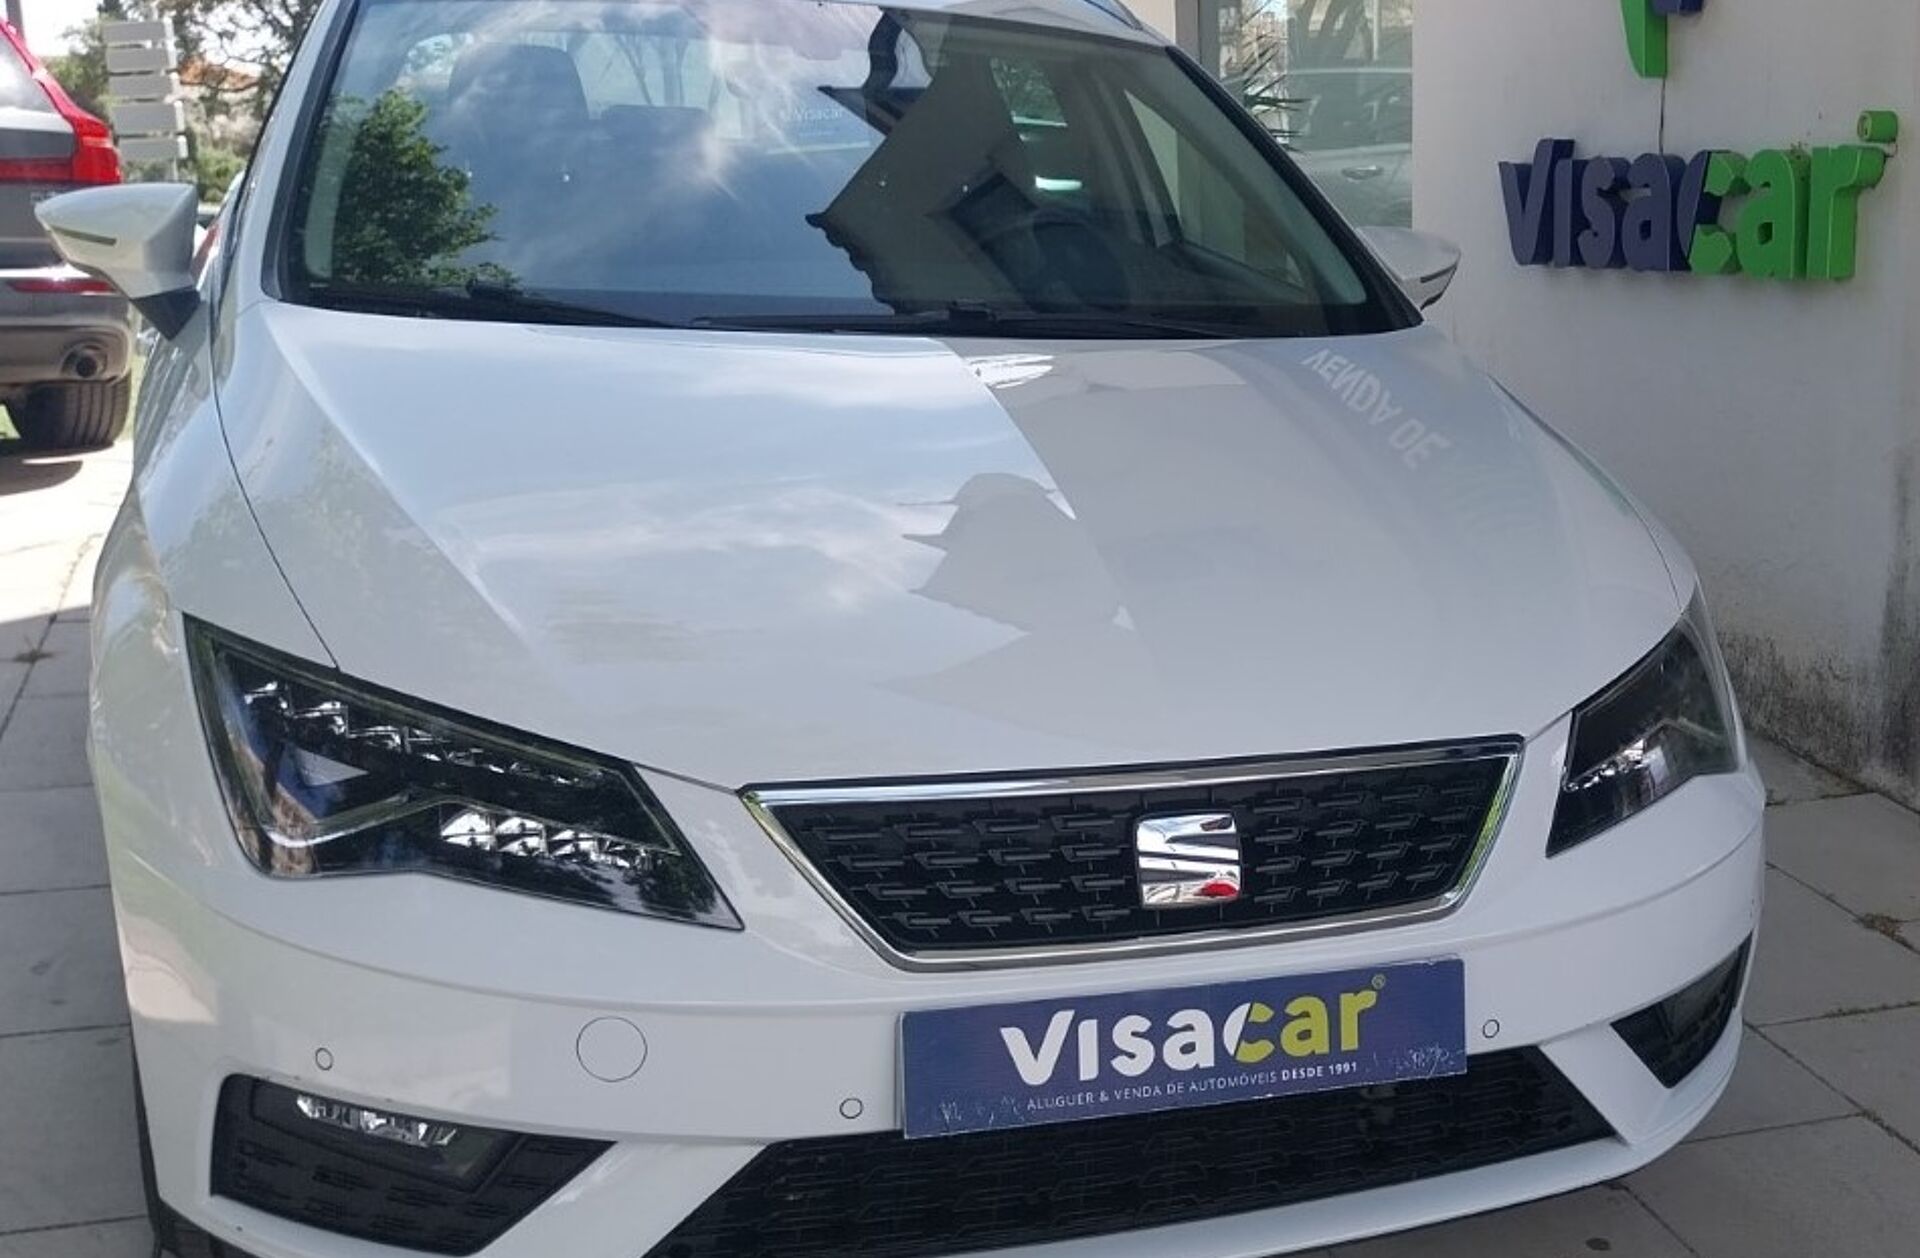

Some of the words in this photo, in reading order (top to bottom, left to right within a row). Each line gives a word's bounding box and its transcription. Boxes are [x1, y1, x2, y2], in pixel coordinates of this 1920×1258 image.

[1027, 1092, 1095, 1110] ALUGUER
[1100, 1090, 1110, 1103] &
[1114, 1085, 1162, 1100] VENDA
[1166, 1081, 1185, 1095] DE
[1189, 1070, 1278, 1092] AUTOMÓVEIS
[1282, 1066, 1324, 1081] DESDE
[1328, 1061, 1358, 1076] 1991
